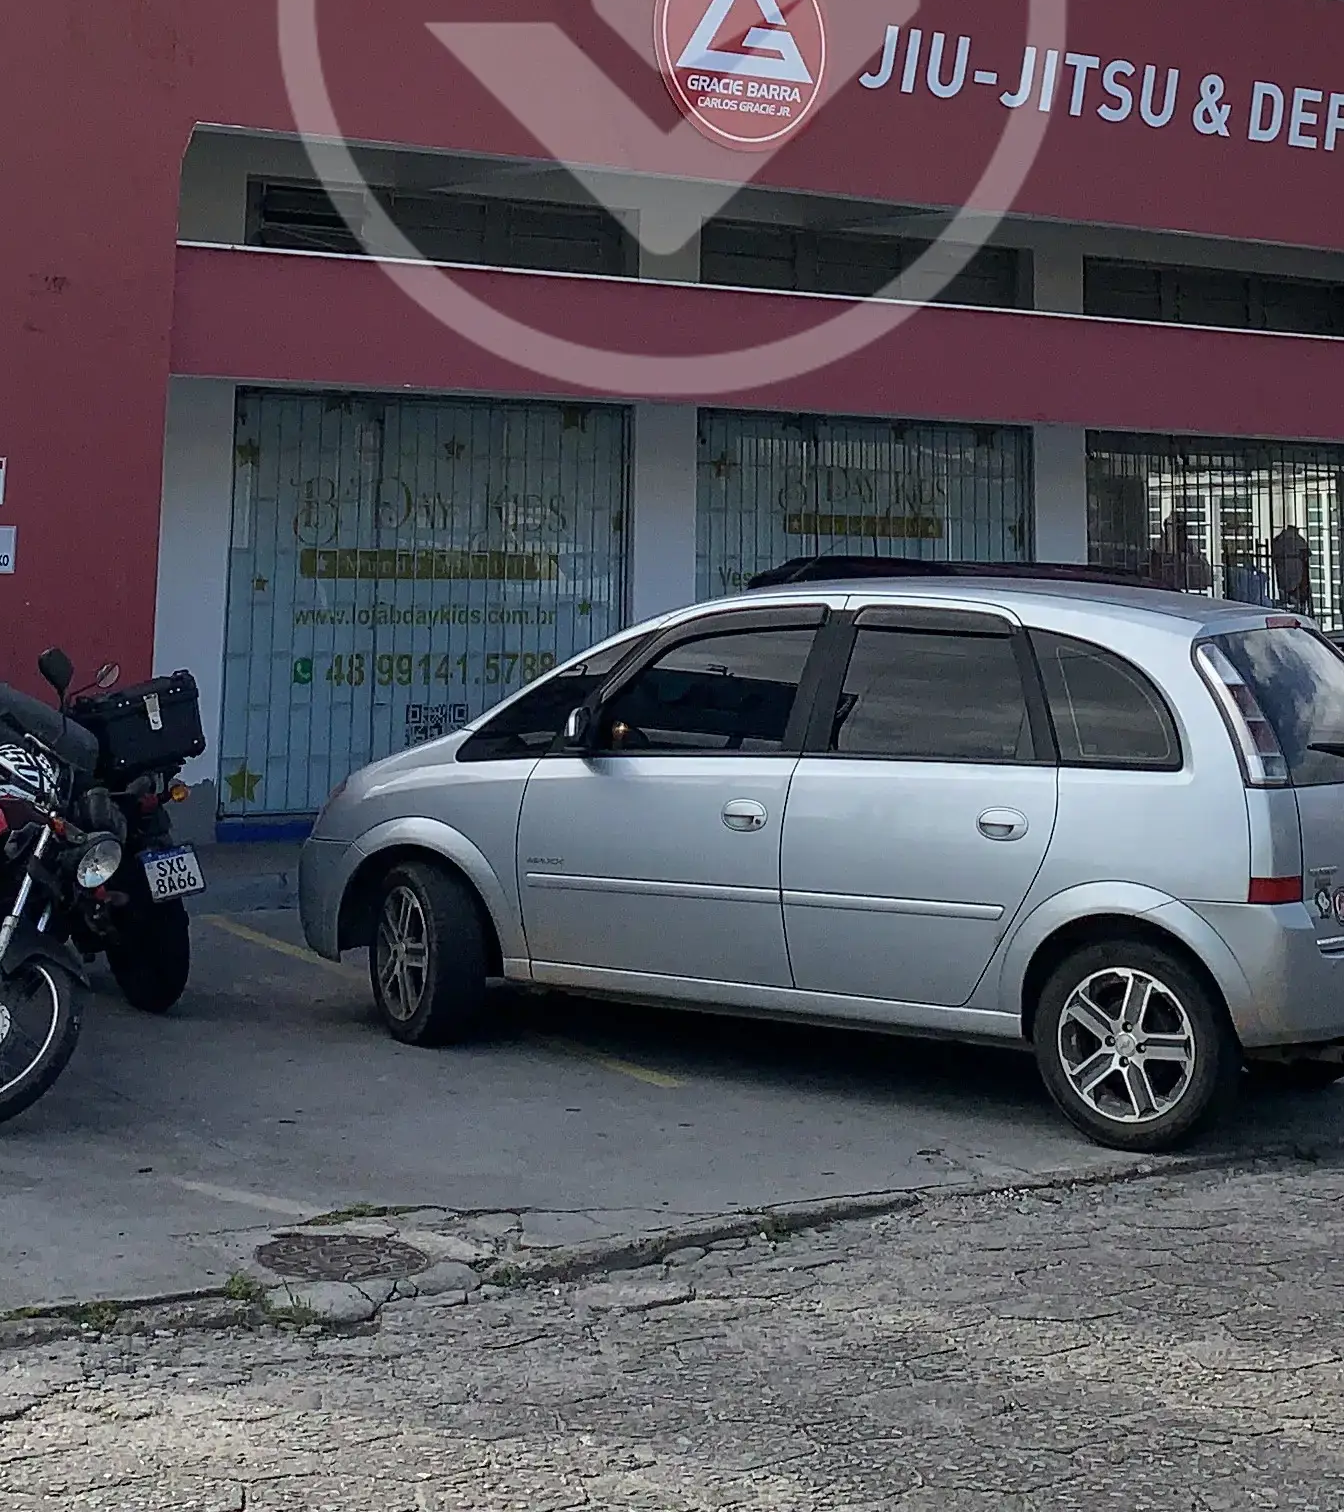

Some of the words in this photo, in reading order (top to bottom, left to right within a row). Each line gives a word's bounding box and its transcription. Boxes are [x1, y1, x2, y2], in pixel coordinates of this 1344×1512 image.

[687, 74, 744, 96] GRACIE
[746, 81, 802, 103] BARRA
[859, 24, 1180, 129] JIU-JITSU
[1193, 73, 1232, 138] &
[697, 96, 738, 111] CARLOS
[739, 101, 776, 116] GRACIE
[325, 653, 365, 687] 48
[156, 856, 187, 878] SXC
[156, 872, 197, 895] 8A66
